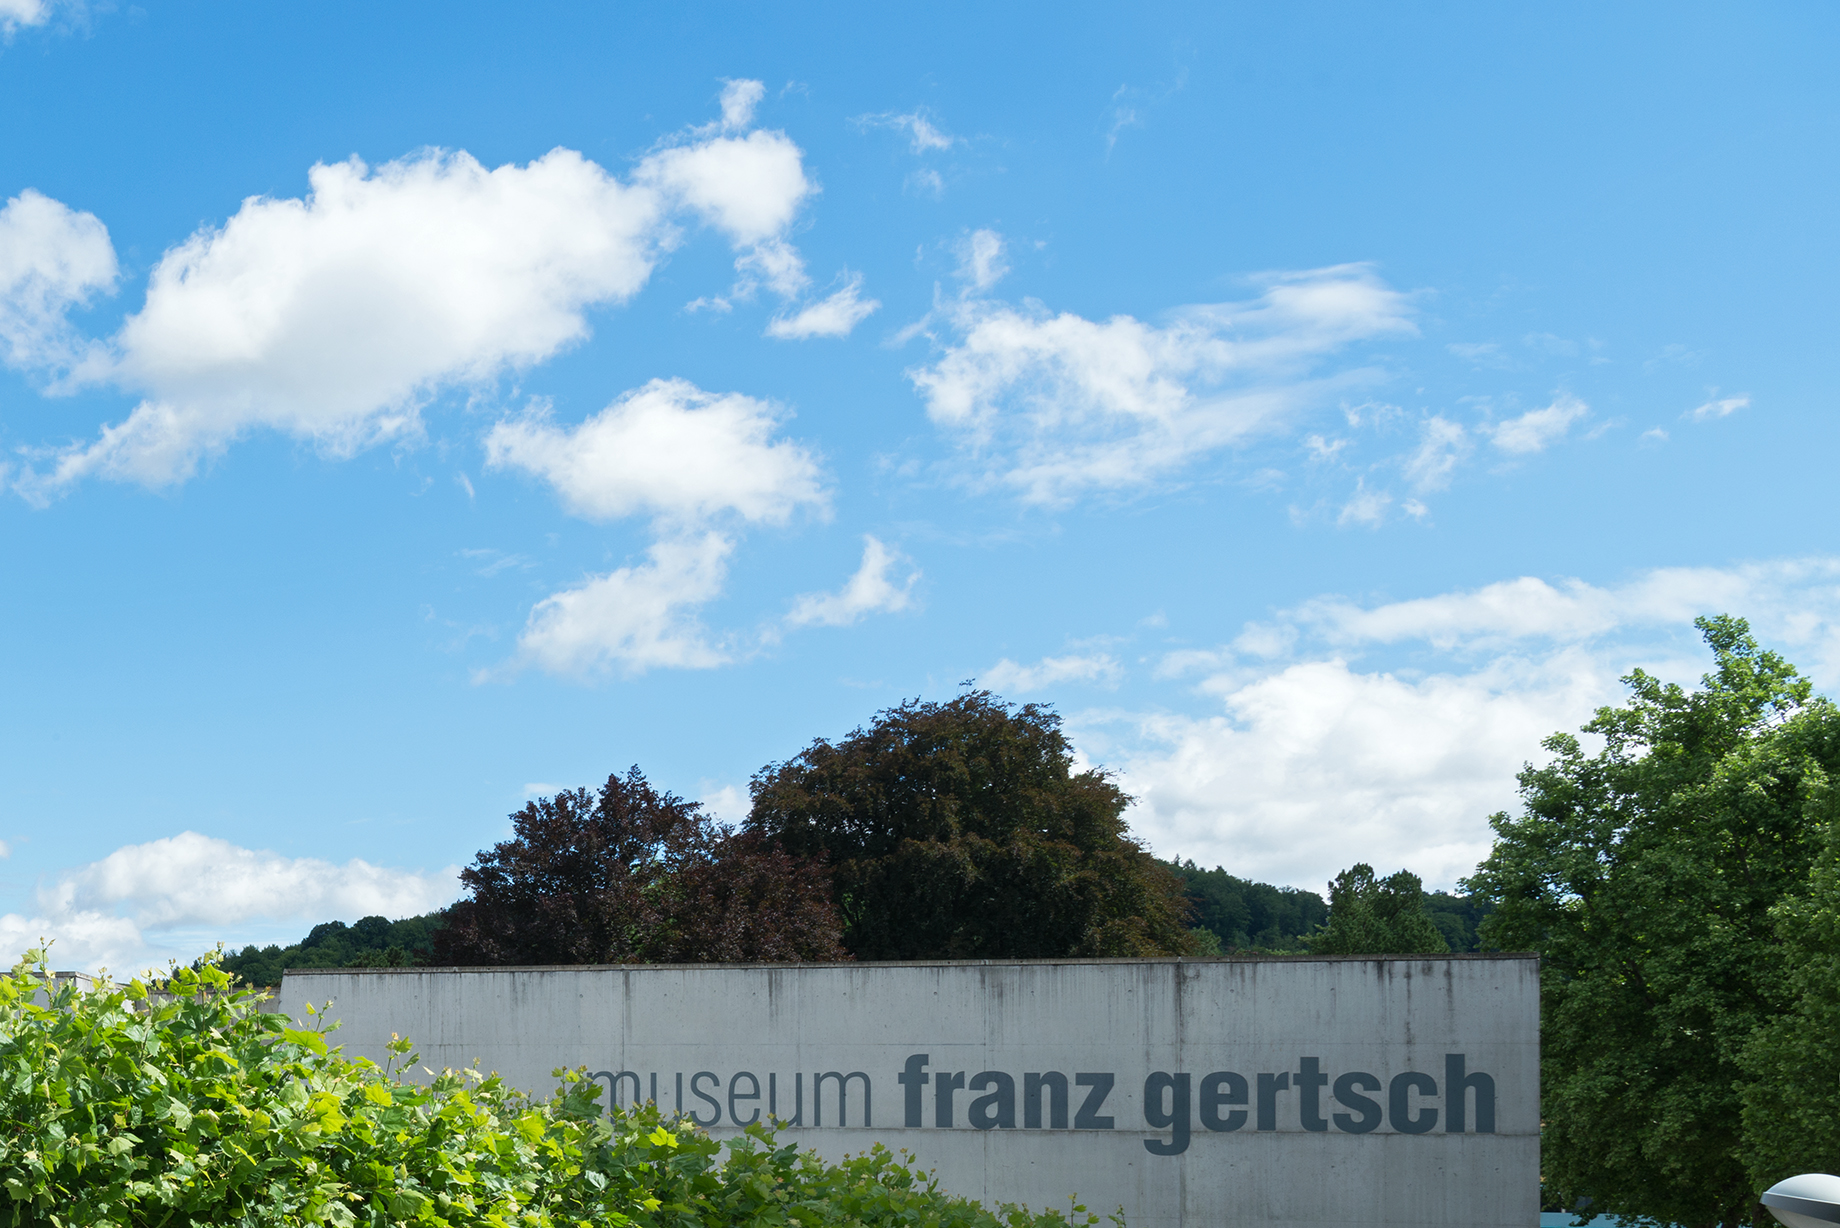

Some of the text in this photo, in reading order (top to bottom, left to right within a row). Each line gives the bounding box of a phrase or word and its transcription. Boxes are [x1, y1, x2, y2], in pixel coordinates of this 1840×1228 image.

[587, 1054, 1496, 1156] museum franz gertsch
